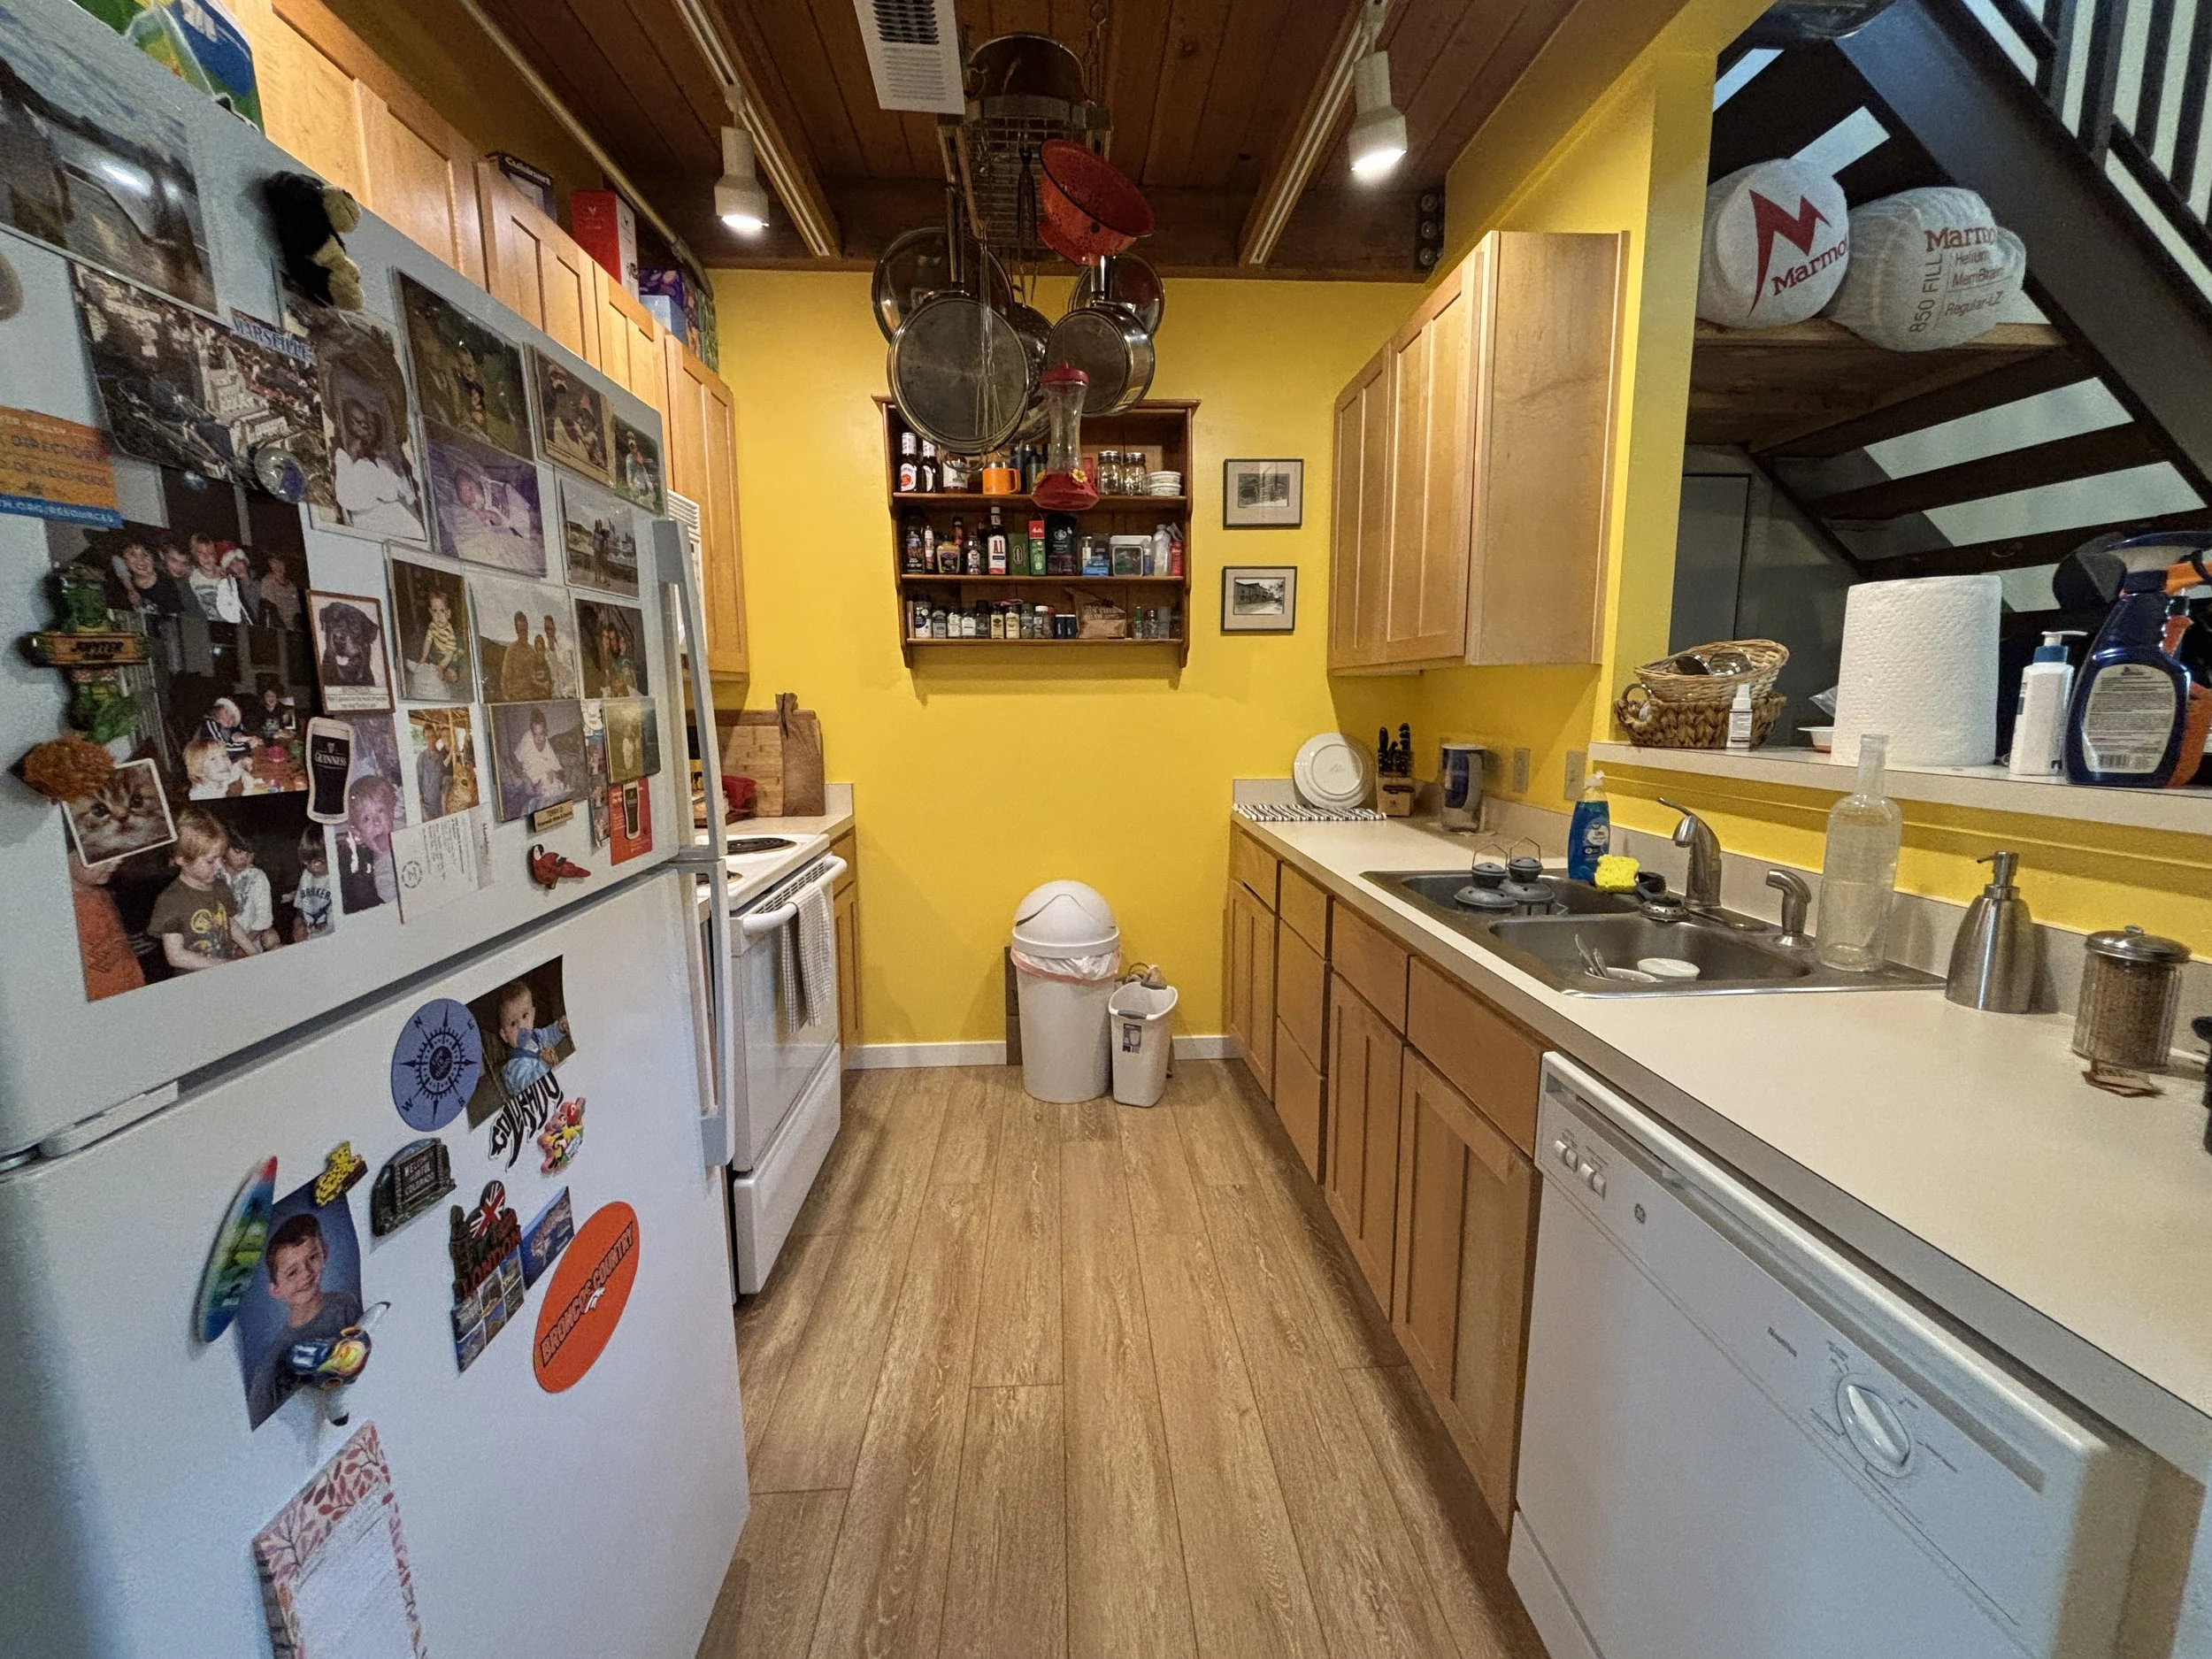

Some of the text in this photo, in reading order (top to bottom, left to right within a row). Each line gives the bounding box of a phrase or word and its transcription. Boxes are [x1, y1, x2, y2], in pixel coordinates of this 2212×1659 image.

[1924, 227, 1998, 252] Marmo
[1909, 253, 1943, 333] 850 FILL
[314, 751, 348, 767] GUINNESS
[540, 1221, 634, 1367] BRONCOS COUNTRY
